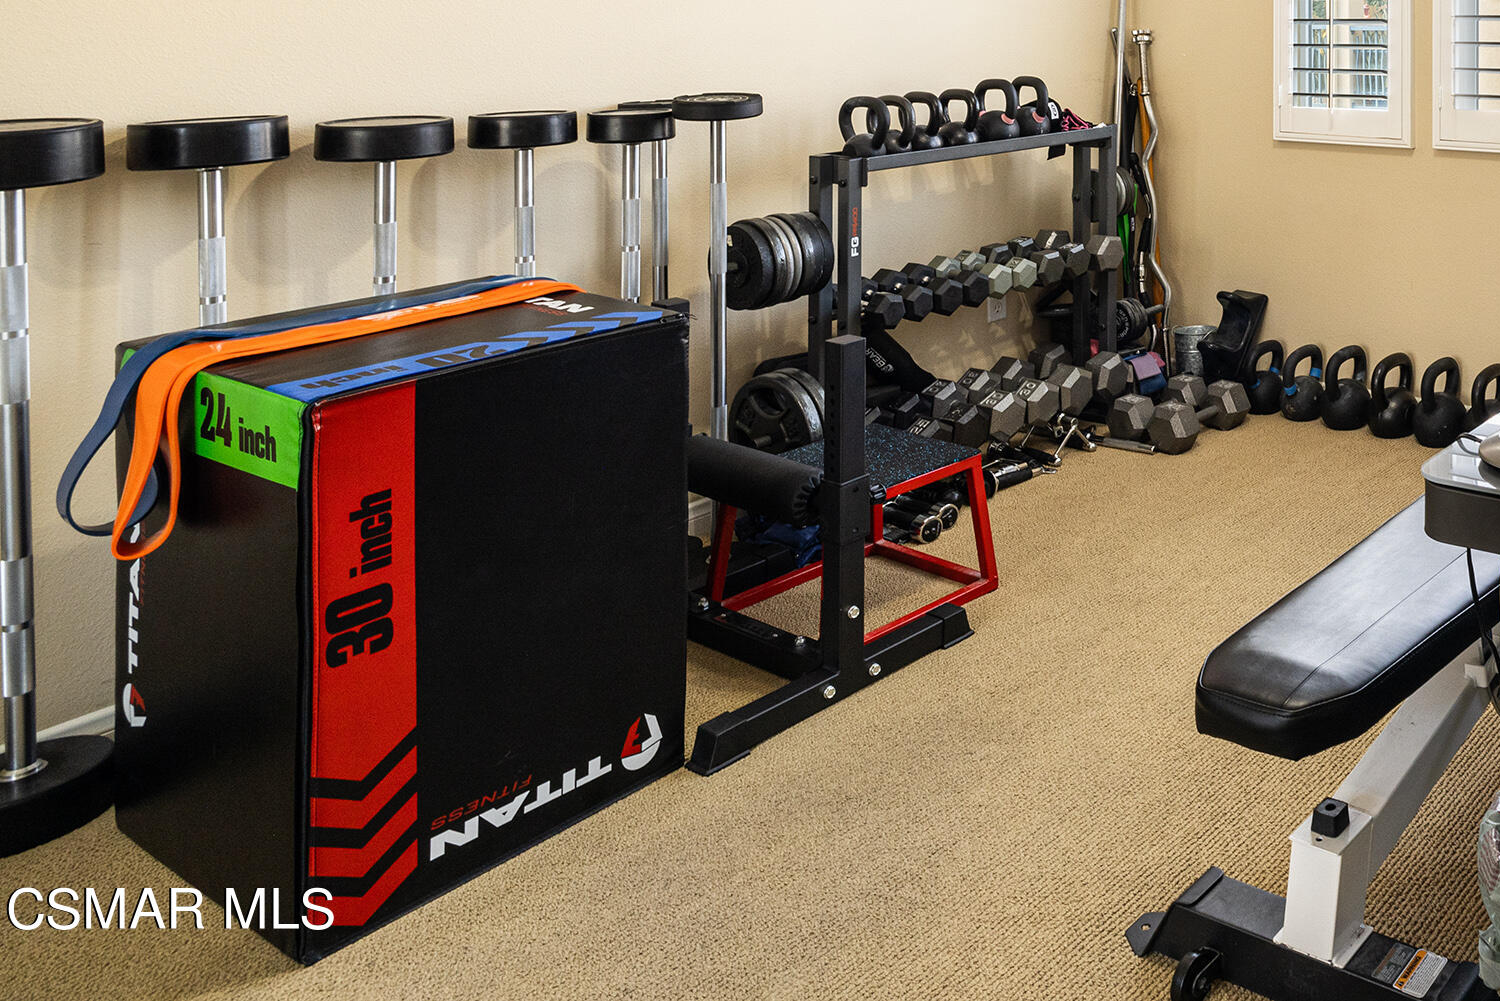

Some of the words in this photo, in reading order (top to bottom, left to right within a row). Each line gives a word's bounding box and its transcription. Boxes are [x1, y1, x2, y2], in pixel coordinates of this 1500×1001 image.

[524, 297, 595, 313] TAN
[301, 363, 409, 390] inch
[416, 341, 504, 368] 20
[200, 387, 233, 447] 24
[238, 417, 277, 463] inch
[349, 488, 393, 579] inch
[325, 582, 394, 669] 30
[429, 755, 613, 862] TITAN
[430, 773, 533, 832] FITNESS
